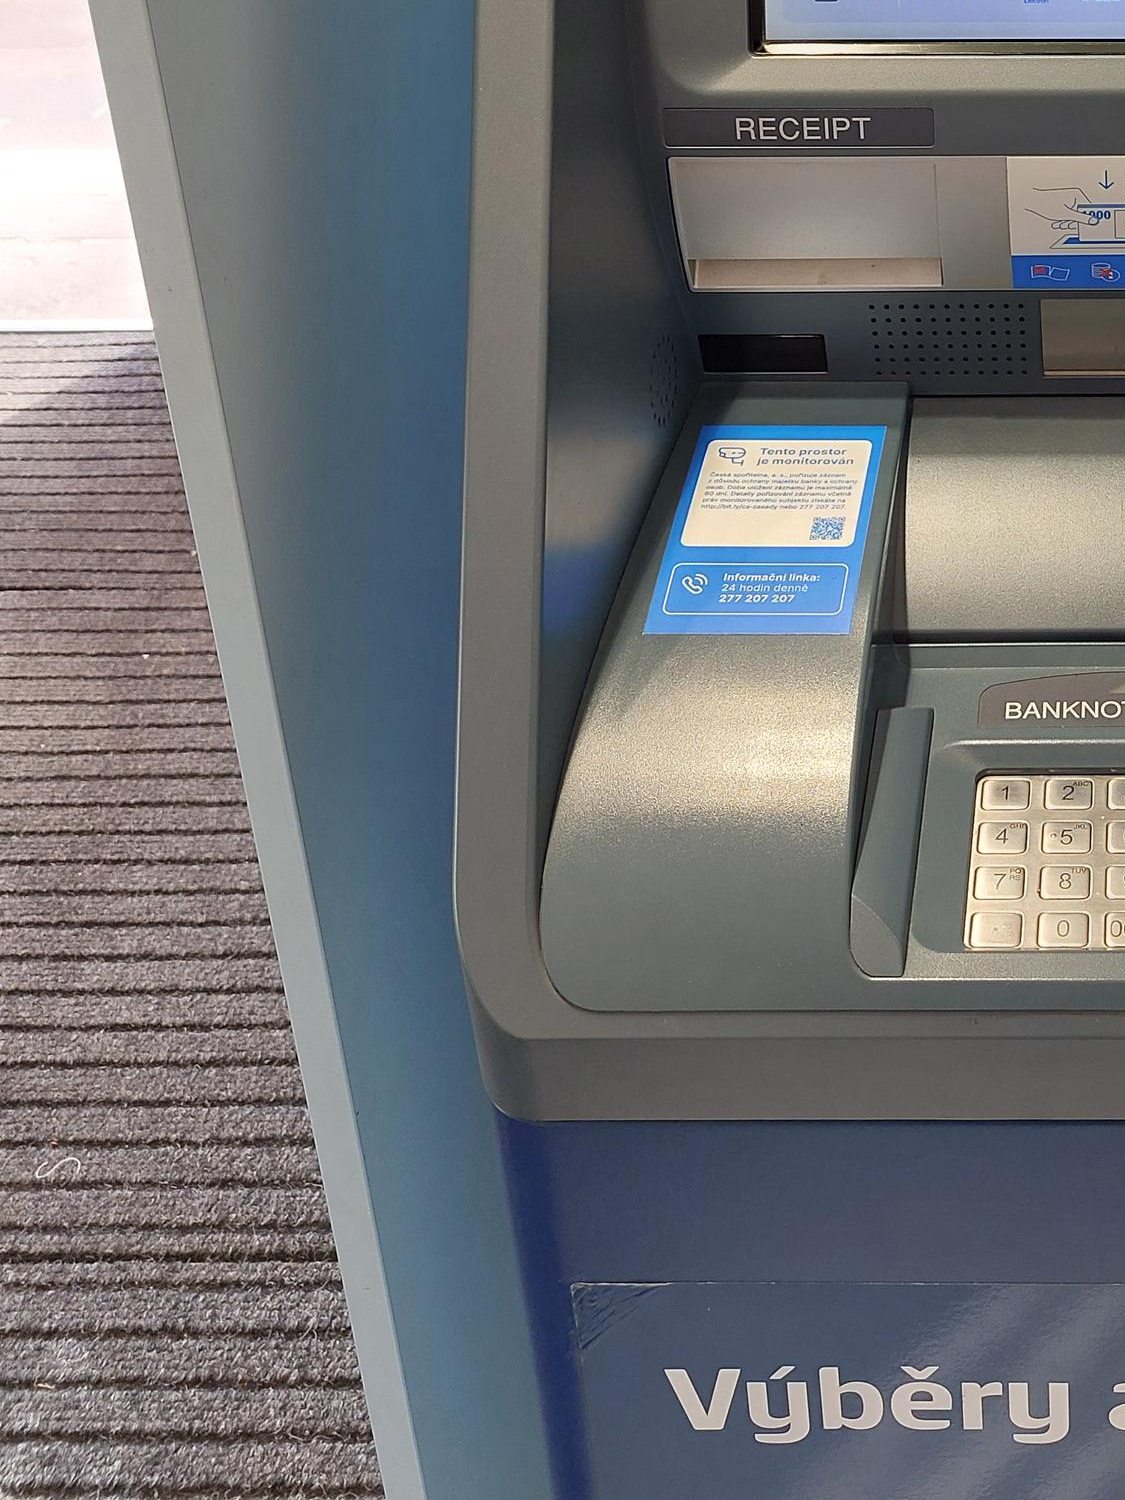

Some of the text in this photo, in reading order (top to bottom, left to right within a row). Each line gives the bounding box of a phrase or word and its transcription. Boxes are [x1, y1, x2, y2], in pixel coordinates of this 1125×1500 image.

[733, 116, 872, 141] RECEIPT
[760, 448, 847, 457] Tento prostor
[757, 457, 854, 466] je monitorován
[723, 572, 821, 582] Informační linka:
[721, 584, 809, 592] 24 hodin denně
[719, 594, 795, 603] 277 207 207
[1000, 786, 1010, 800] 1
[1061, 785, 1075, 801] 2
[995, 828, 1009, 844] 4
[1060, 829, 1073, 845] 5
[993, 874, 1007, 890] 7
[1058, 873, 1072, 890] 8
[1056, 920, 1070, 938] 0
[664, 1366, 1069, 1444] Výběry
